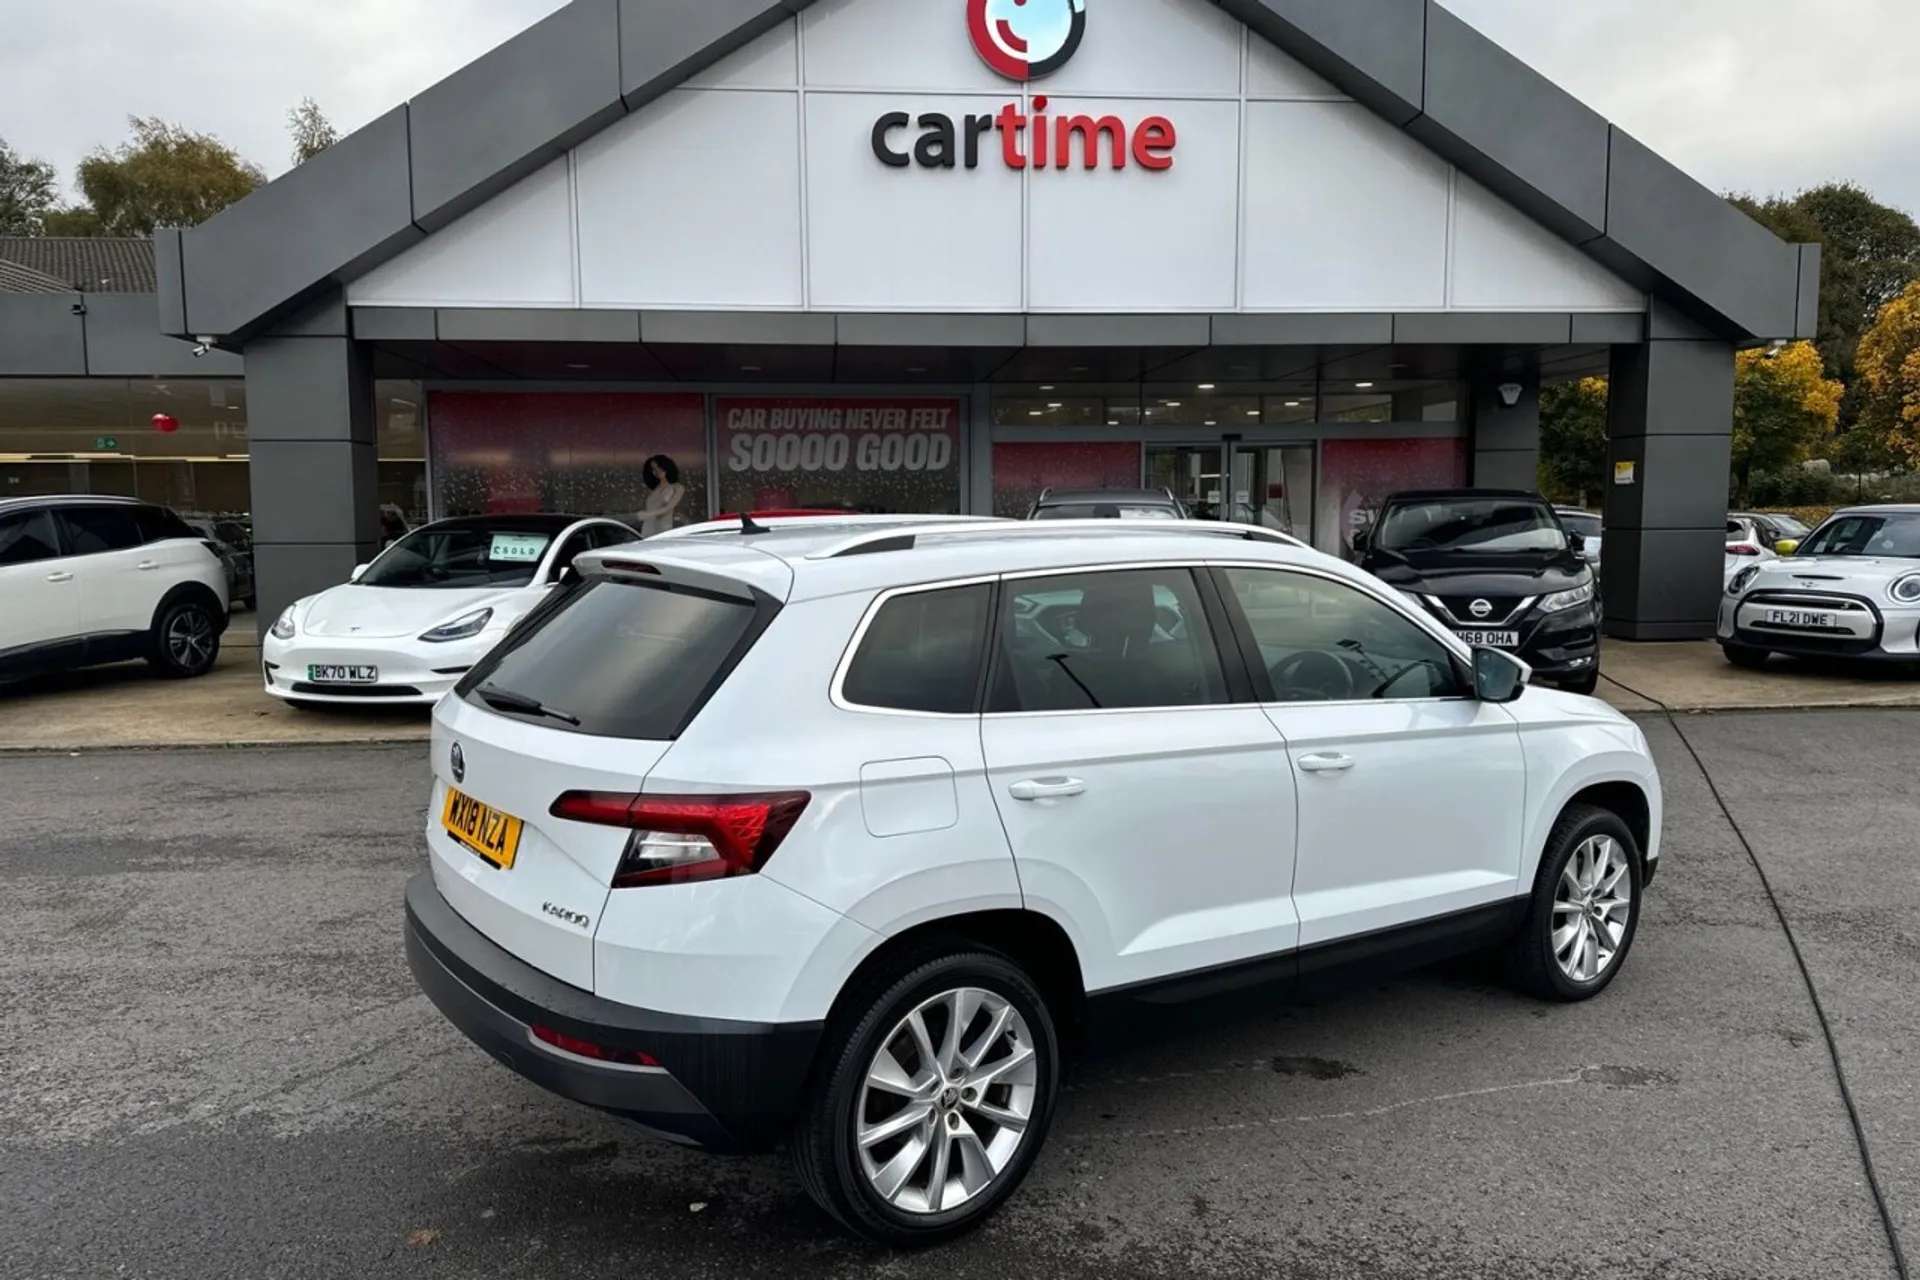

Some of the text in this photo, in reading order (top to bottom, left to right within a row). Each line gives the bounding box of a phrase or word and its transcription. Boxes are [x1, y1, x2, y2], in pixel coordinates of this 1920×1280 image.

[871, 95, 1177, 170] cartime
[728, 408, 952, 430] CAR BUYING NEVER FELT
[728, 433, 952, 472] SOOOO GOOD
[1772, 609, 1828, 625] FL21 DWE
[1456, 631, 1513, 645] H68 OHA
[315, 664, 375, 679] BK70 WLZ
[476, 804, 509, 855] NZA
